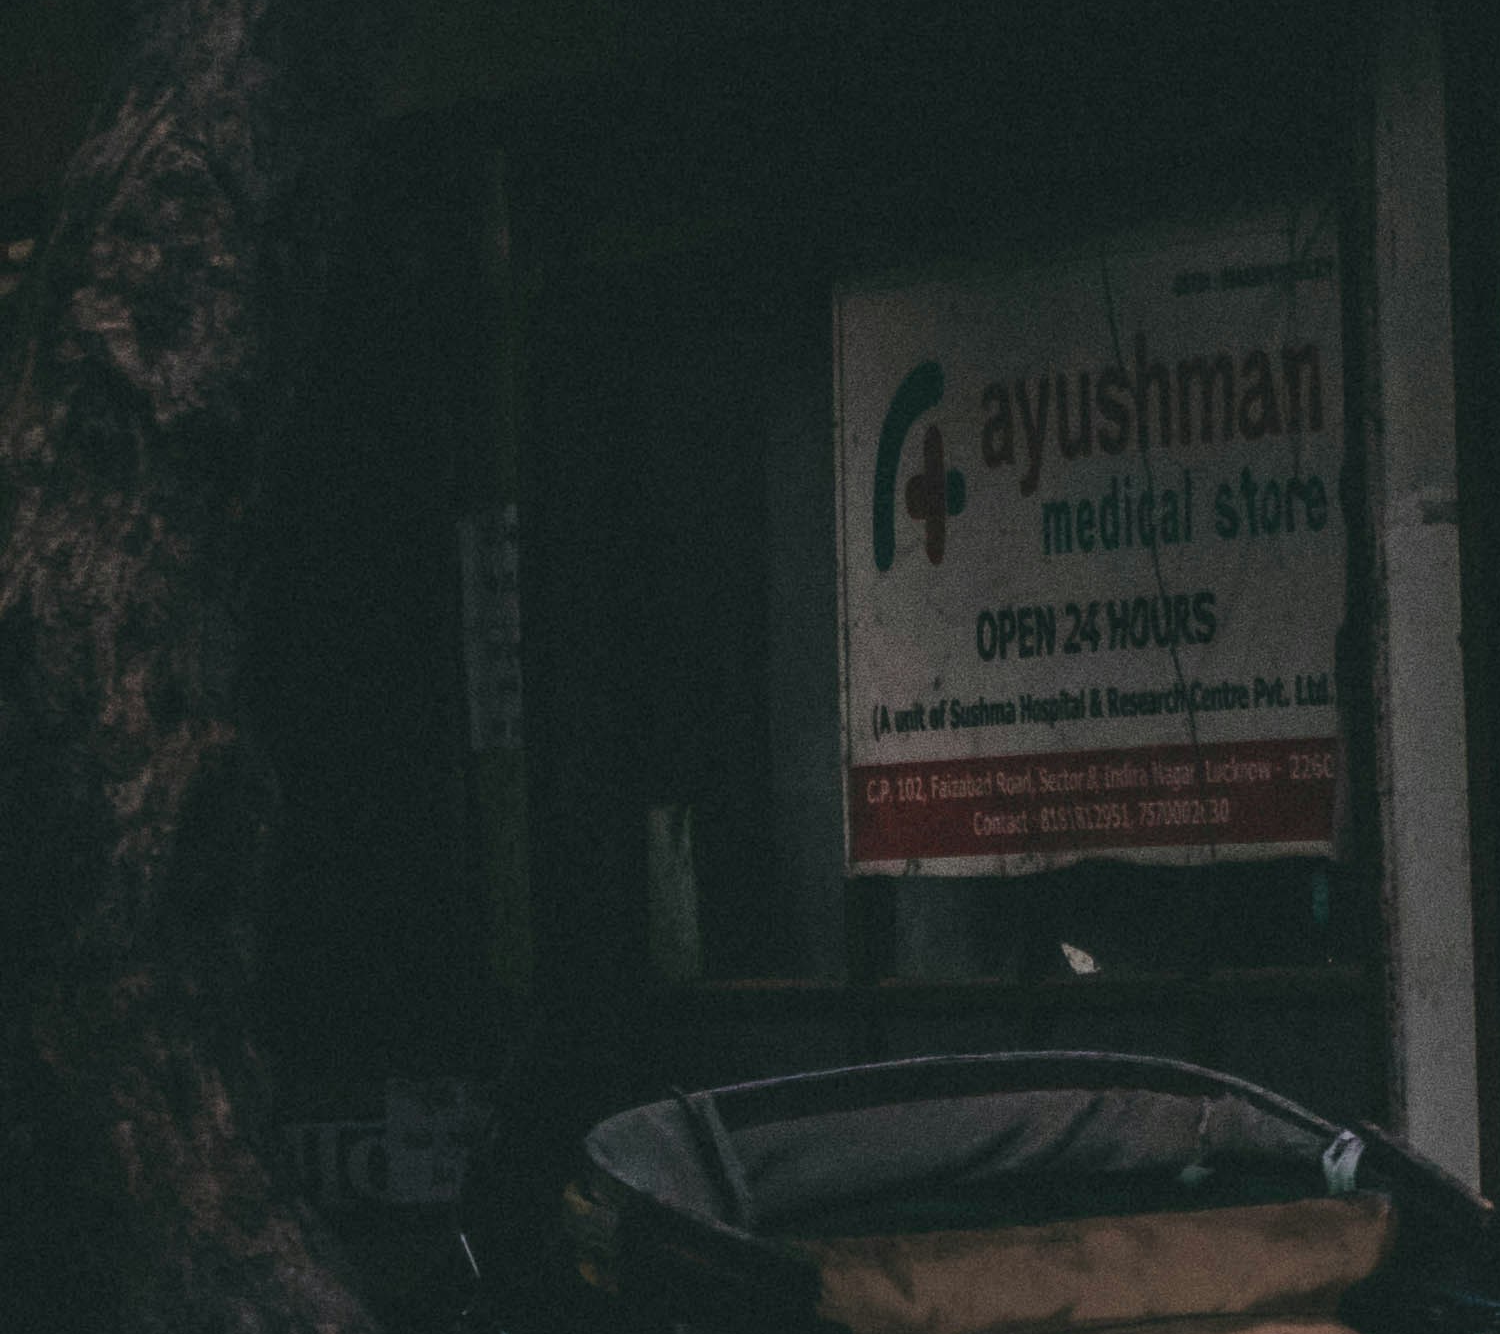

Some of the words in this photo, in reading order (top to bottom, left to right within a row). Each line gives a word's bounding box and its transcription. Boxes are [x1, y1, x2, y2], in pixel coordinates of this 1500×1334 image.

[981, 332, 1326, 497] ayushman
[1041, 467, 1195, 556] medical
[1212, 465, 1329, 541] store
[975, 603, 1056, 662] OPEN
[1063, 601, 1101, 655] 24
[1106, 591, 1217, 651] HOURS
[894, 701, 926, 733] unit
[928, 698, 947, 730] of
[949, 696, 1018, 730] Sushma
[1019, 687, 1086, 729] Hospital
[1105, 680, 1185, 719] Research
[1188, 677, 1250, 712] Centre
